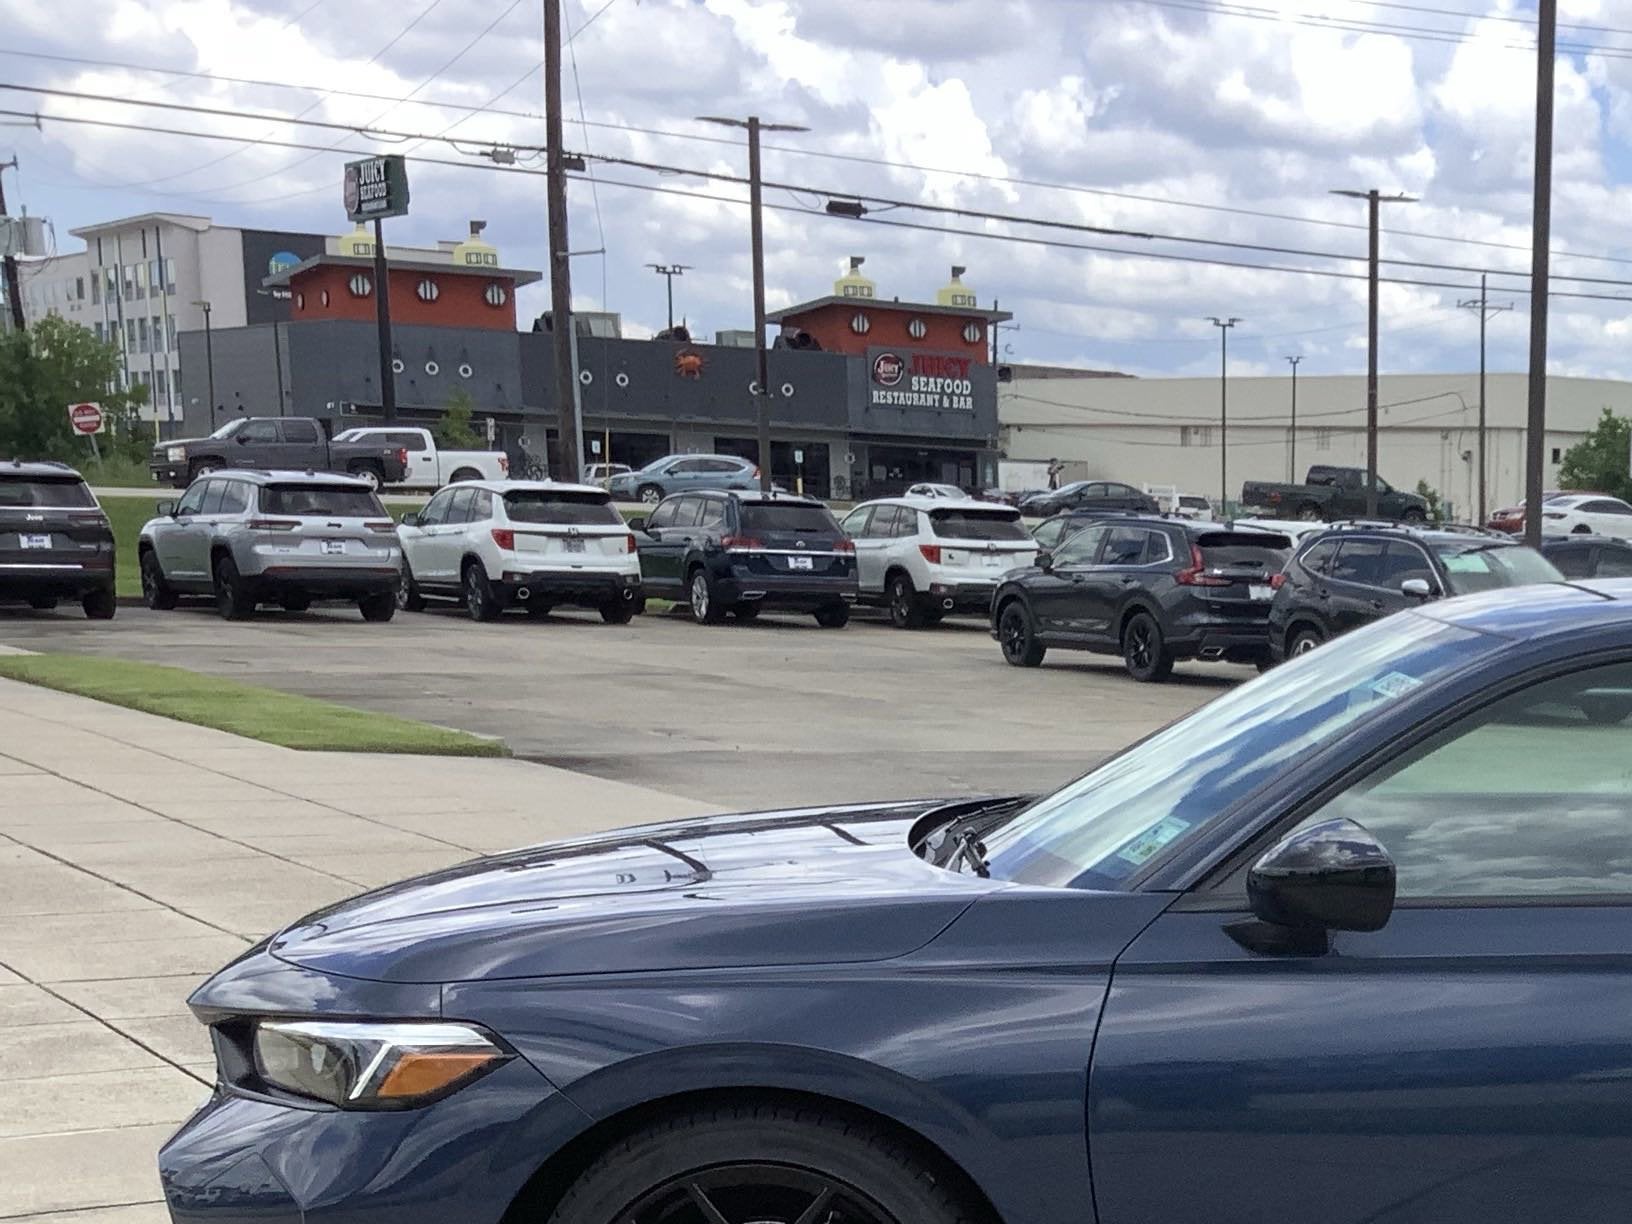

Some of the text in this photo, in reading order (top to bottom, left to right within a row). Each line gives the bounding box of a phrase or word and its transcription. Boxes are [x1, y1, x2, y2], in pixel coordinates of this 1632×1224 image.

[359, 160, 386, 185] JUICY
[908, 353, 970, 378] JUICY
[911, 376, 972, 395] SEAFOOD
[872, 390, 973, 409] RESTAURANT & BAR
